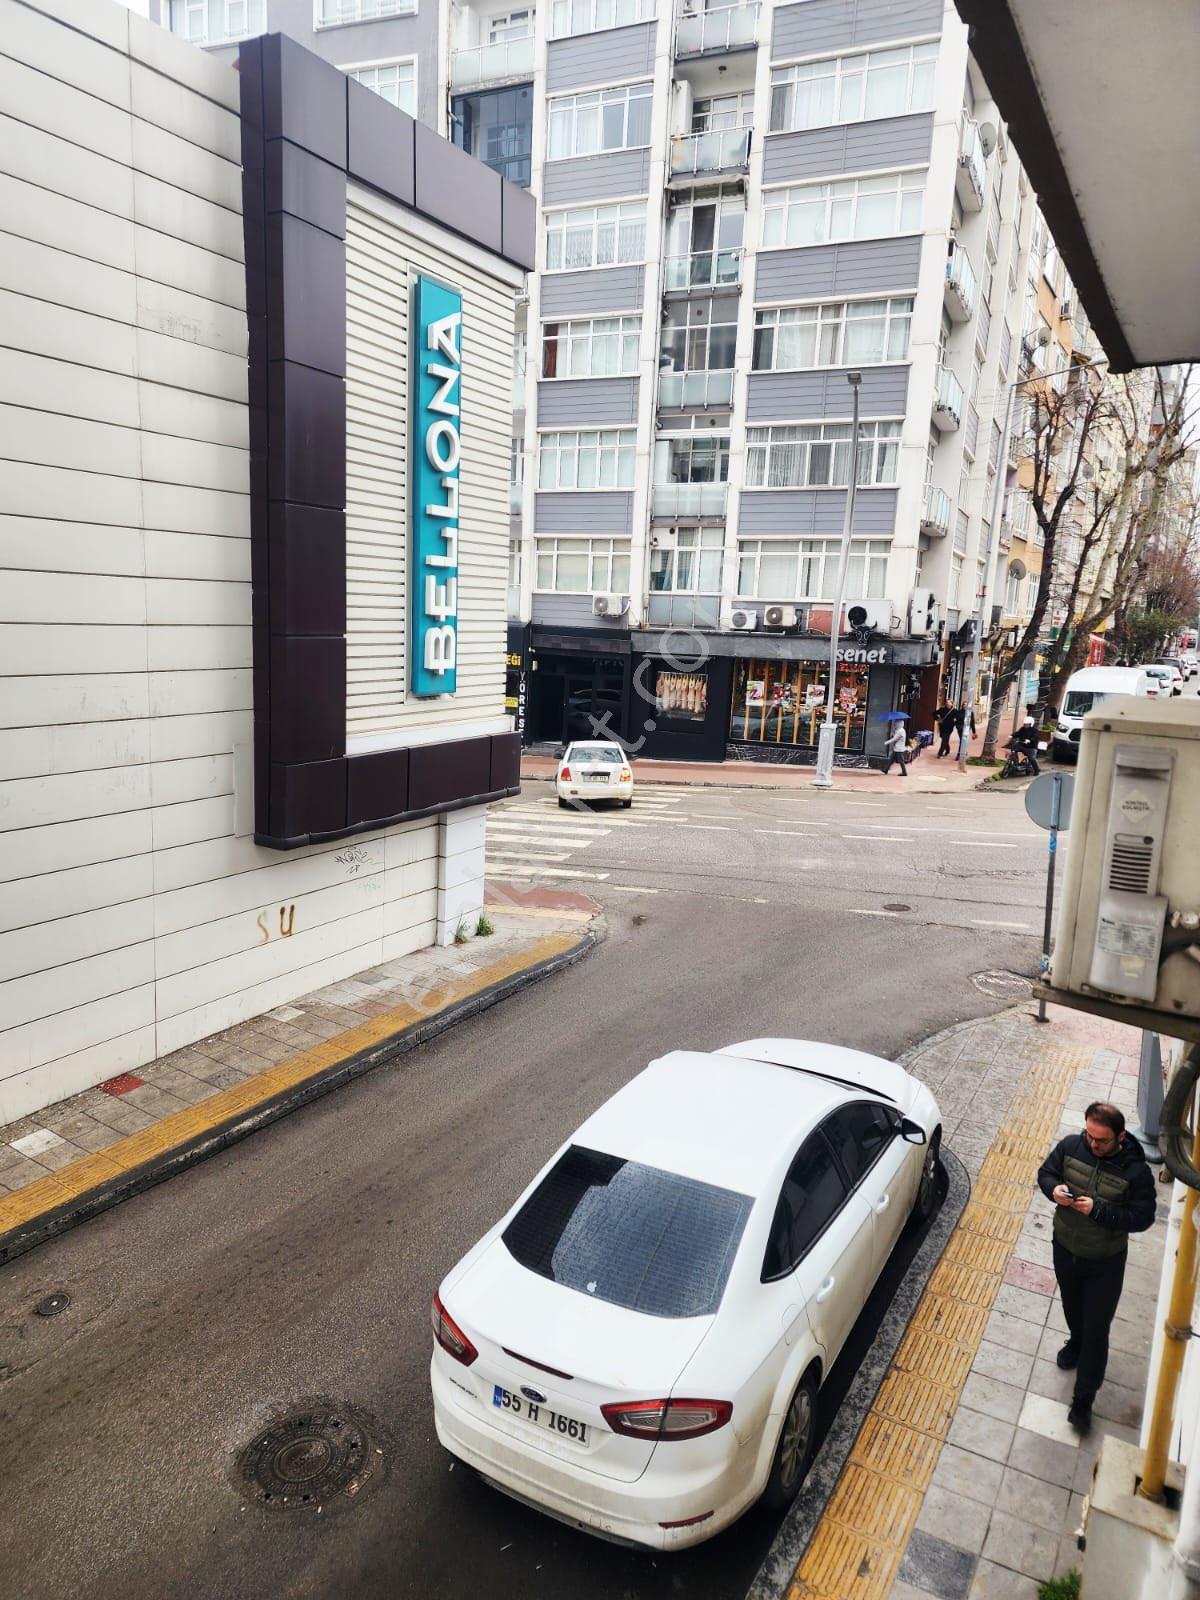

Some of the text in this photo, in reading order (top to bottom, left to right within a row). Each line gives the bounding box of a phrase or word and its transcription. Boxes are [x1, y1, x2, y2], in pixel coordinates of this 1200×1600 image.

[424, 312, 462, 676] BELLONA
[836, 647, 887, 664] senet
[518, 671, 526, 748] YÖRES
[502, 1389, 522, 1412] 55
[528, 1403, 539, 1421] H
[548, 1411, 588, 1442] 1661
